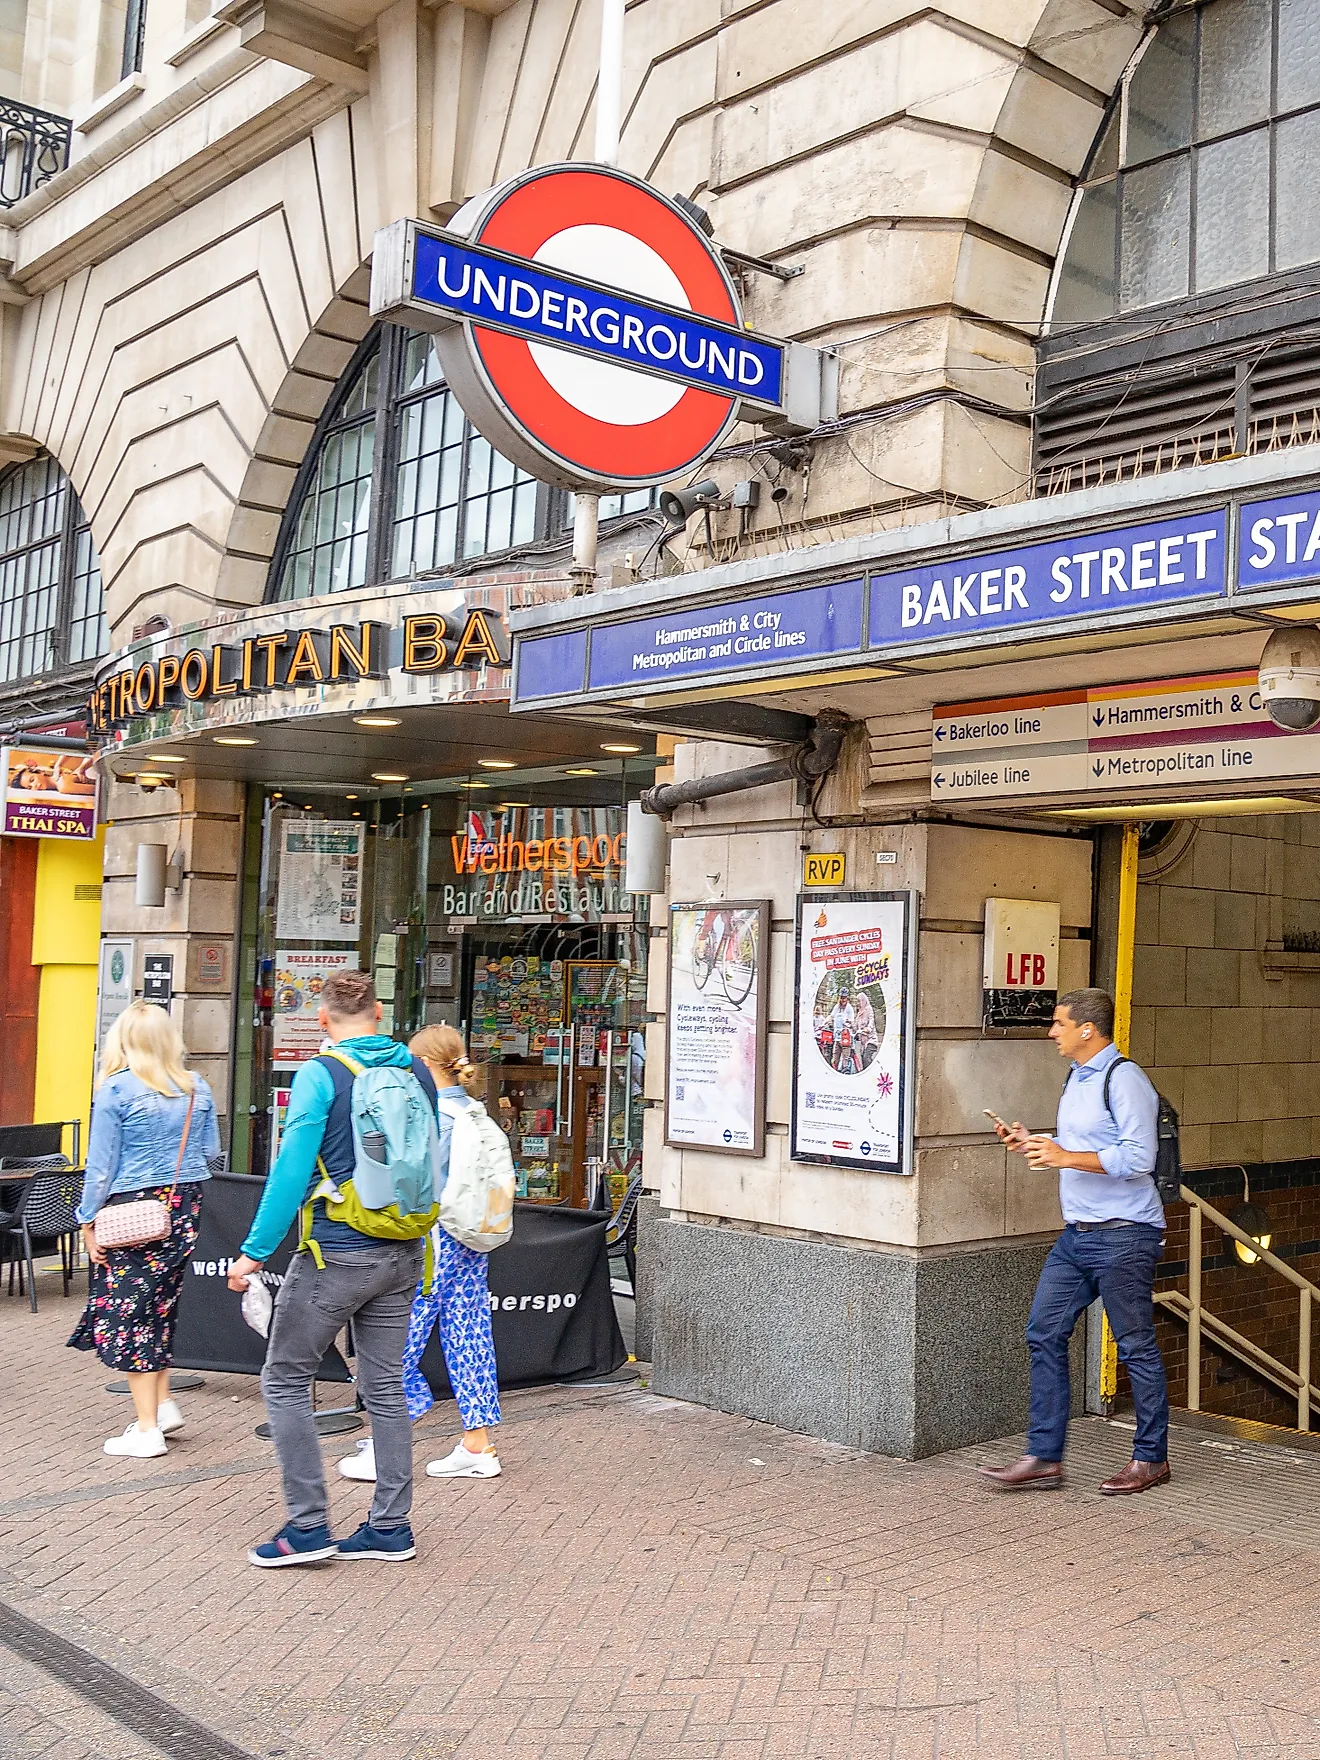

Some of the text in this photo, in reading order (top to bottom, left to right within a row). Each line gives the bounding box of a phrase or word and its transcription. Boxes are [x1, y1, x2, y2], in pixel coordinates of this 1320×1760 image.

[437, 255, 764, 387] UNDERGROUND
[901, 529, 1217, 628] BAKER STREET
[655, 610, 782, 646] Hammersmith & City
[632, 629, 806, 670] Metropolitan and Circle lines
[1107, 699, 1224, 726] Hammersmith
[1230, 694, 1243, 713] &
[950, 717, 1041, 741] Bakerloo line
[1107, 749, 1253, 777] Metropolitan line
[949, 766, 1030, 789] Jubilee line
[9, 816, 86, 834] THAI SPA
[19, 806, 81, 819] BAKER STREET
[808, 859, 841, 880] RVP
[443, 885, 478, 915] Bar
[483, 883, 522, 914] and
[287, 955, 348, 963] BREAKFAST
[864, 958, 889, 974] CYCLE
[1006, 952, 1046, 986] LFB
[856, 969, 890, 986] SUNDAYS
